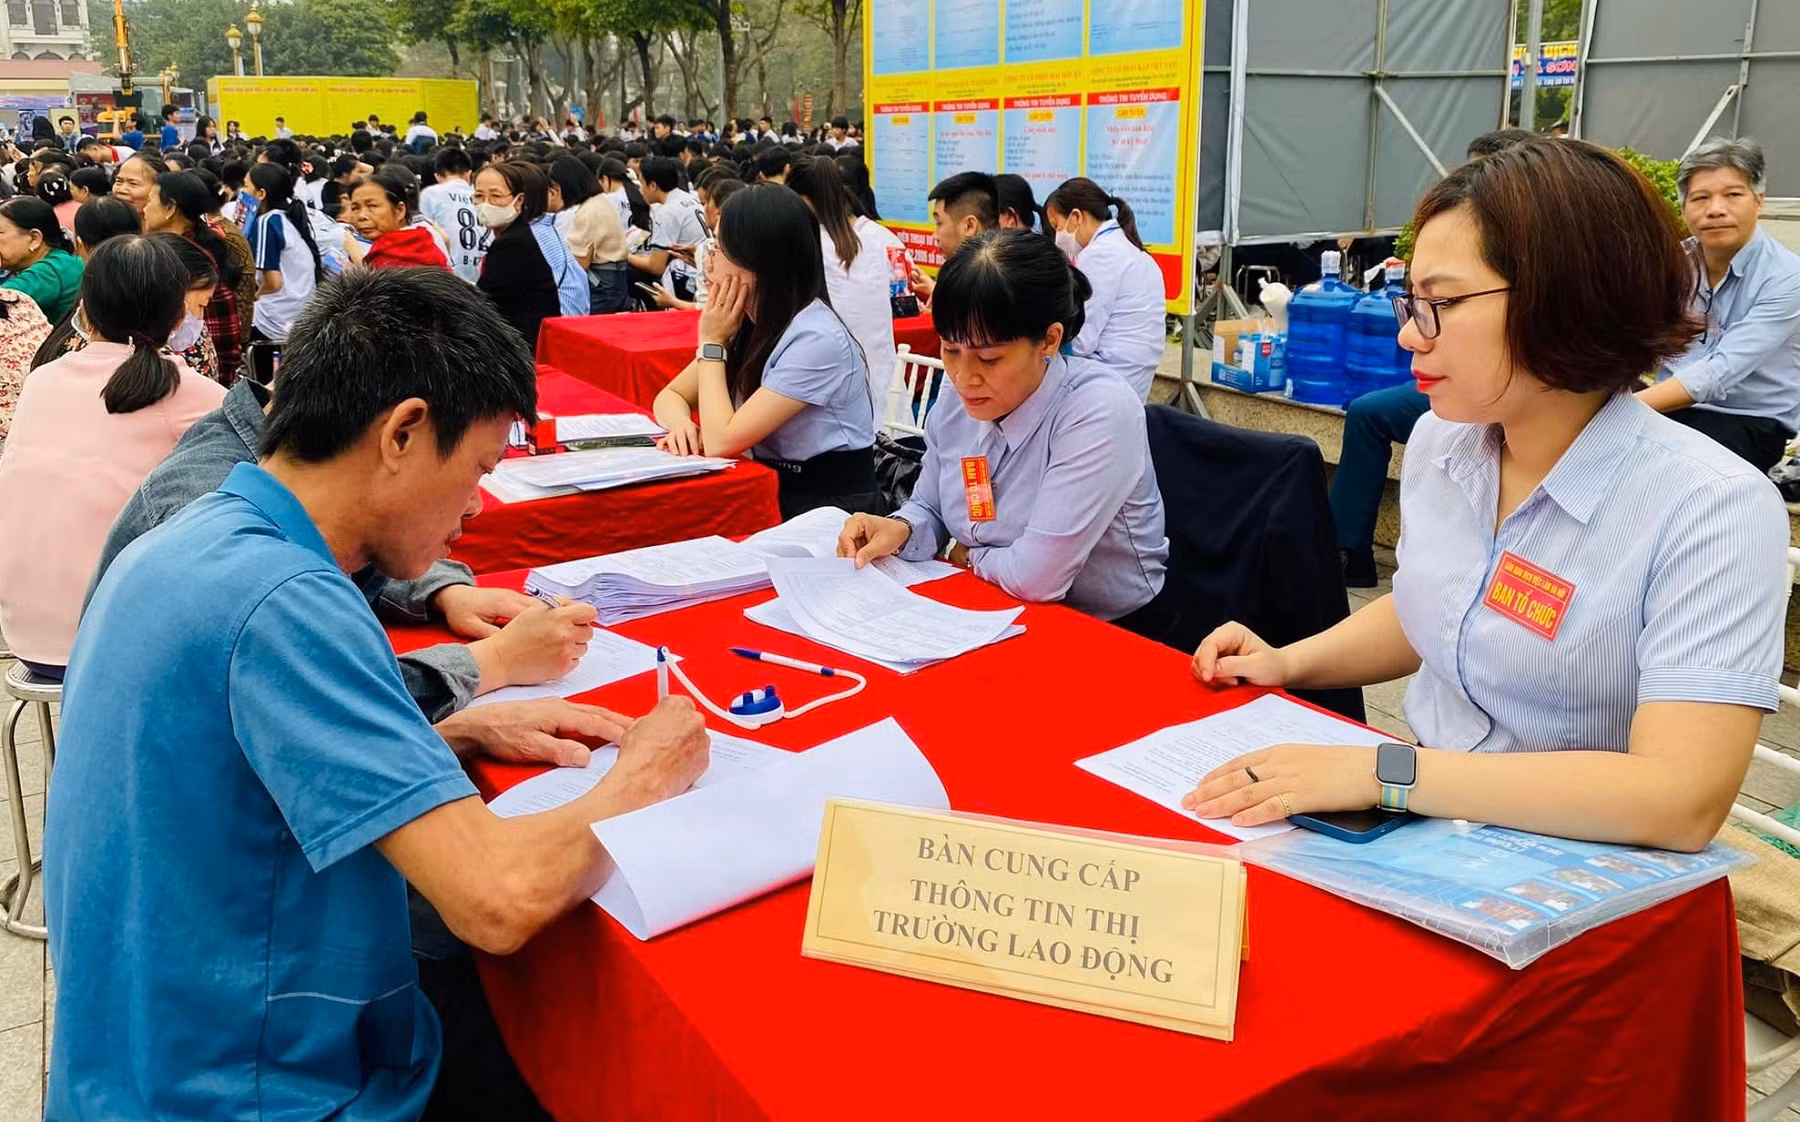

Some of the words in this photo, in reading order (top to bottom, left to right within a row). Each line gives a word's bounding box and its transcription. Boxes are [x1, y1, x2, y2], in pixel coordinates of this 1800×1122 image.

[1491, 581, 1517, 608] BAN
[1512, 589, 1534, 615] TỔ
[1526, 599, 1557, 629] CHỨC
[917, 833, 977, 870] BÀN
[983, 847, 1070, 883] CUNG
[1078, 859, 1142, 893] CẤP
[910, 879, 1016, 919] THÔNG
[1023, 897, 1077, 929] TIN
[1085, 907, 1141, 945] THỊ
[873, 909, 999, 954] TRƯỜNG
[1007, 933, 1072, 966] LAO
[1081, 946, 1174, 985] ĐỘNG
